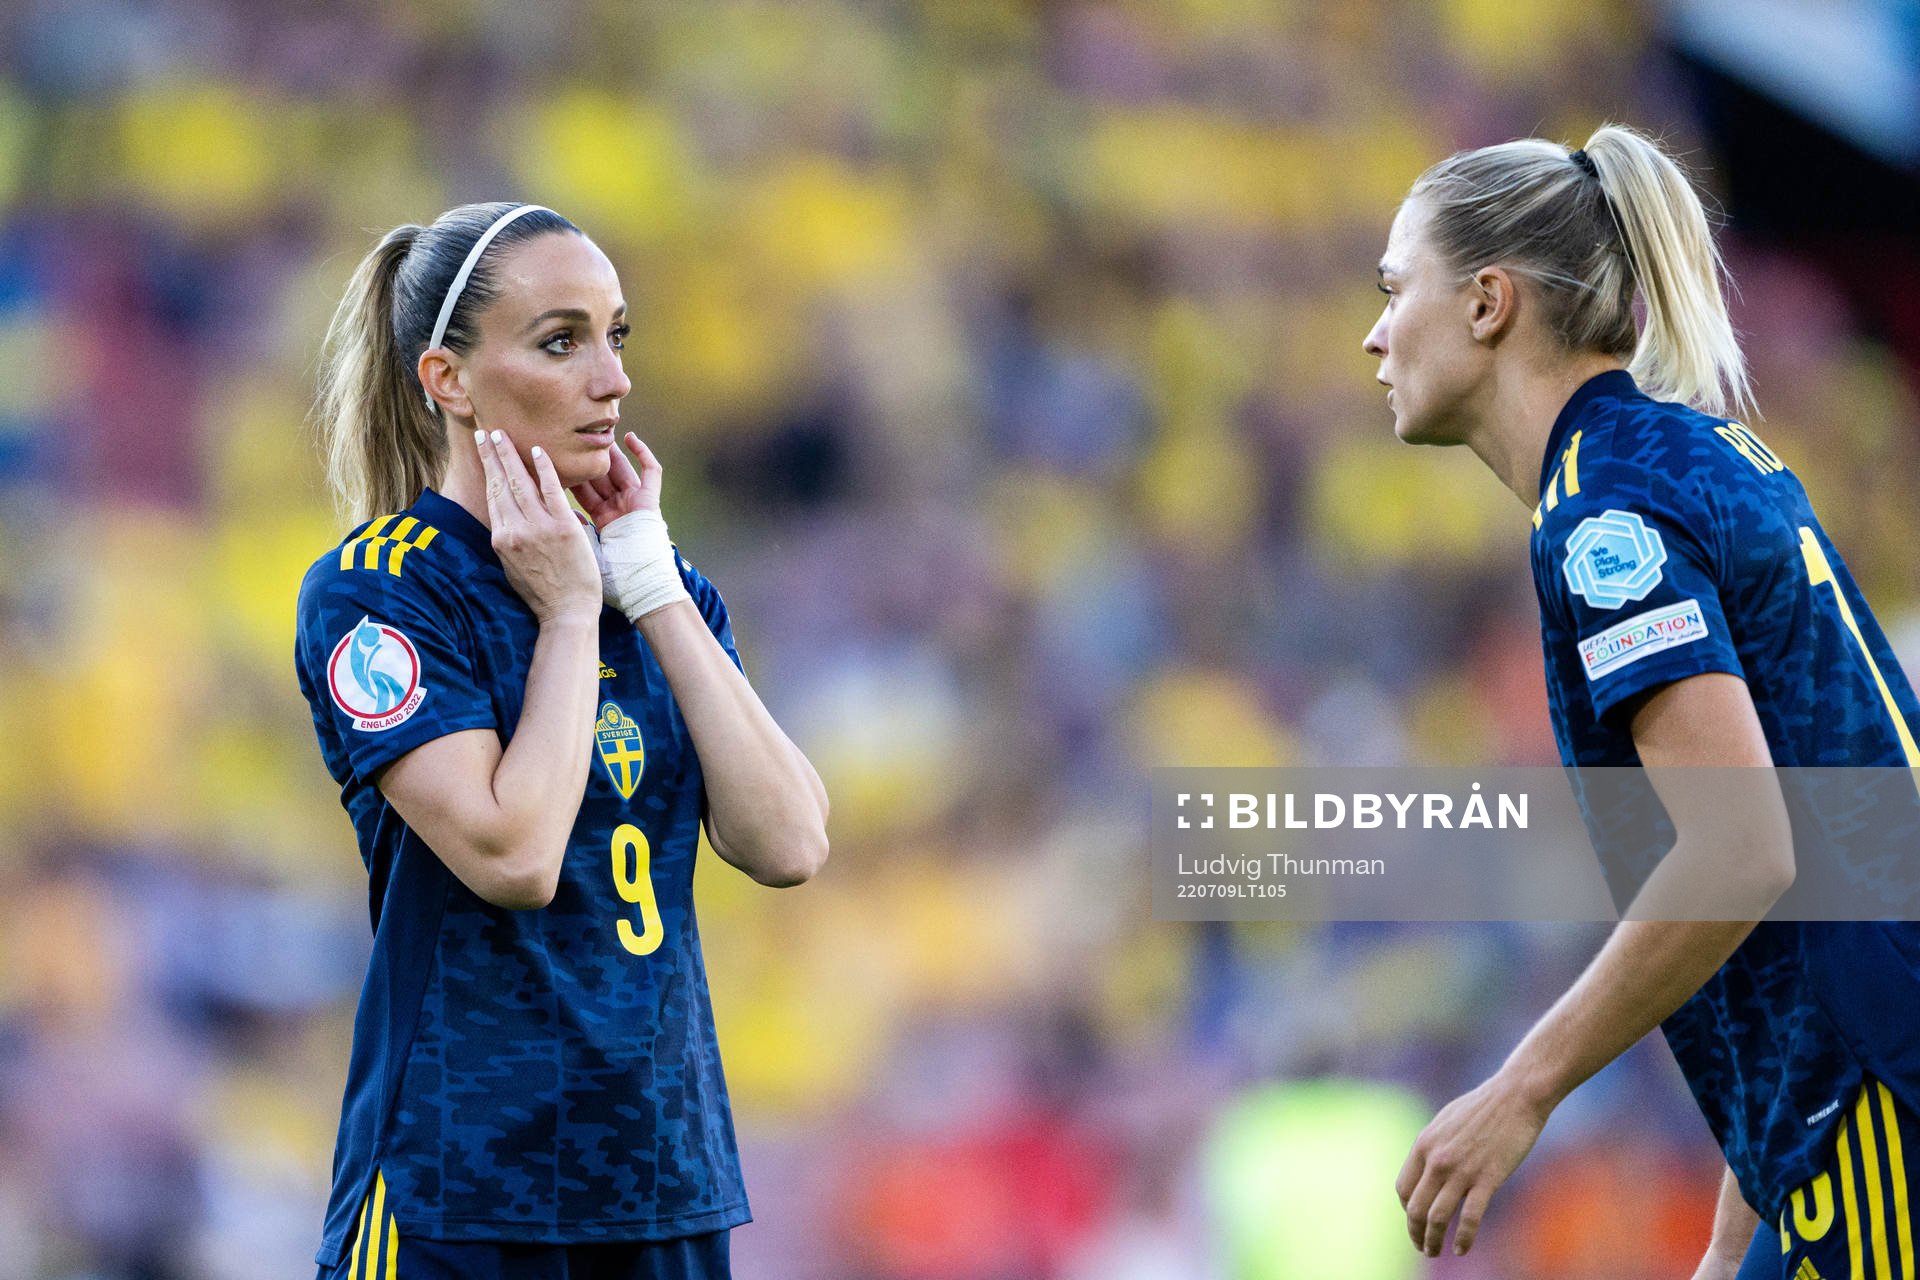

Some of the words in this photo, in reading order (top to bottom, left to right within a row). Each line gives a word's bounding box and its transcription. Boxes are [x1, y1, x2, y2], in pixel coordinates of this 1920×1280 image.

[1713, 423, 1785, 476] RO
[1583, 636, 1606, 652] UEFA
[1586, 613, 1700, 666] FOUNDATION
[361, 713, 404, 729] ENGLAND
[404, 693, 422, 715] 2022
[602, 729, 634, 739] SVERIGE
[611, 823, 664, 956] 9
